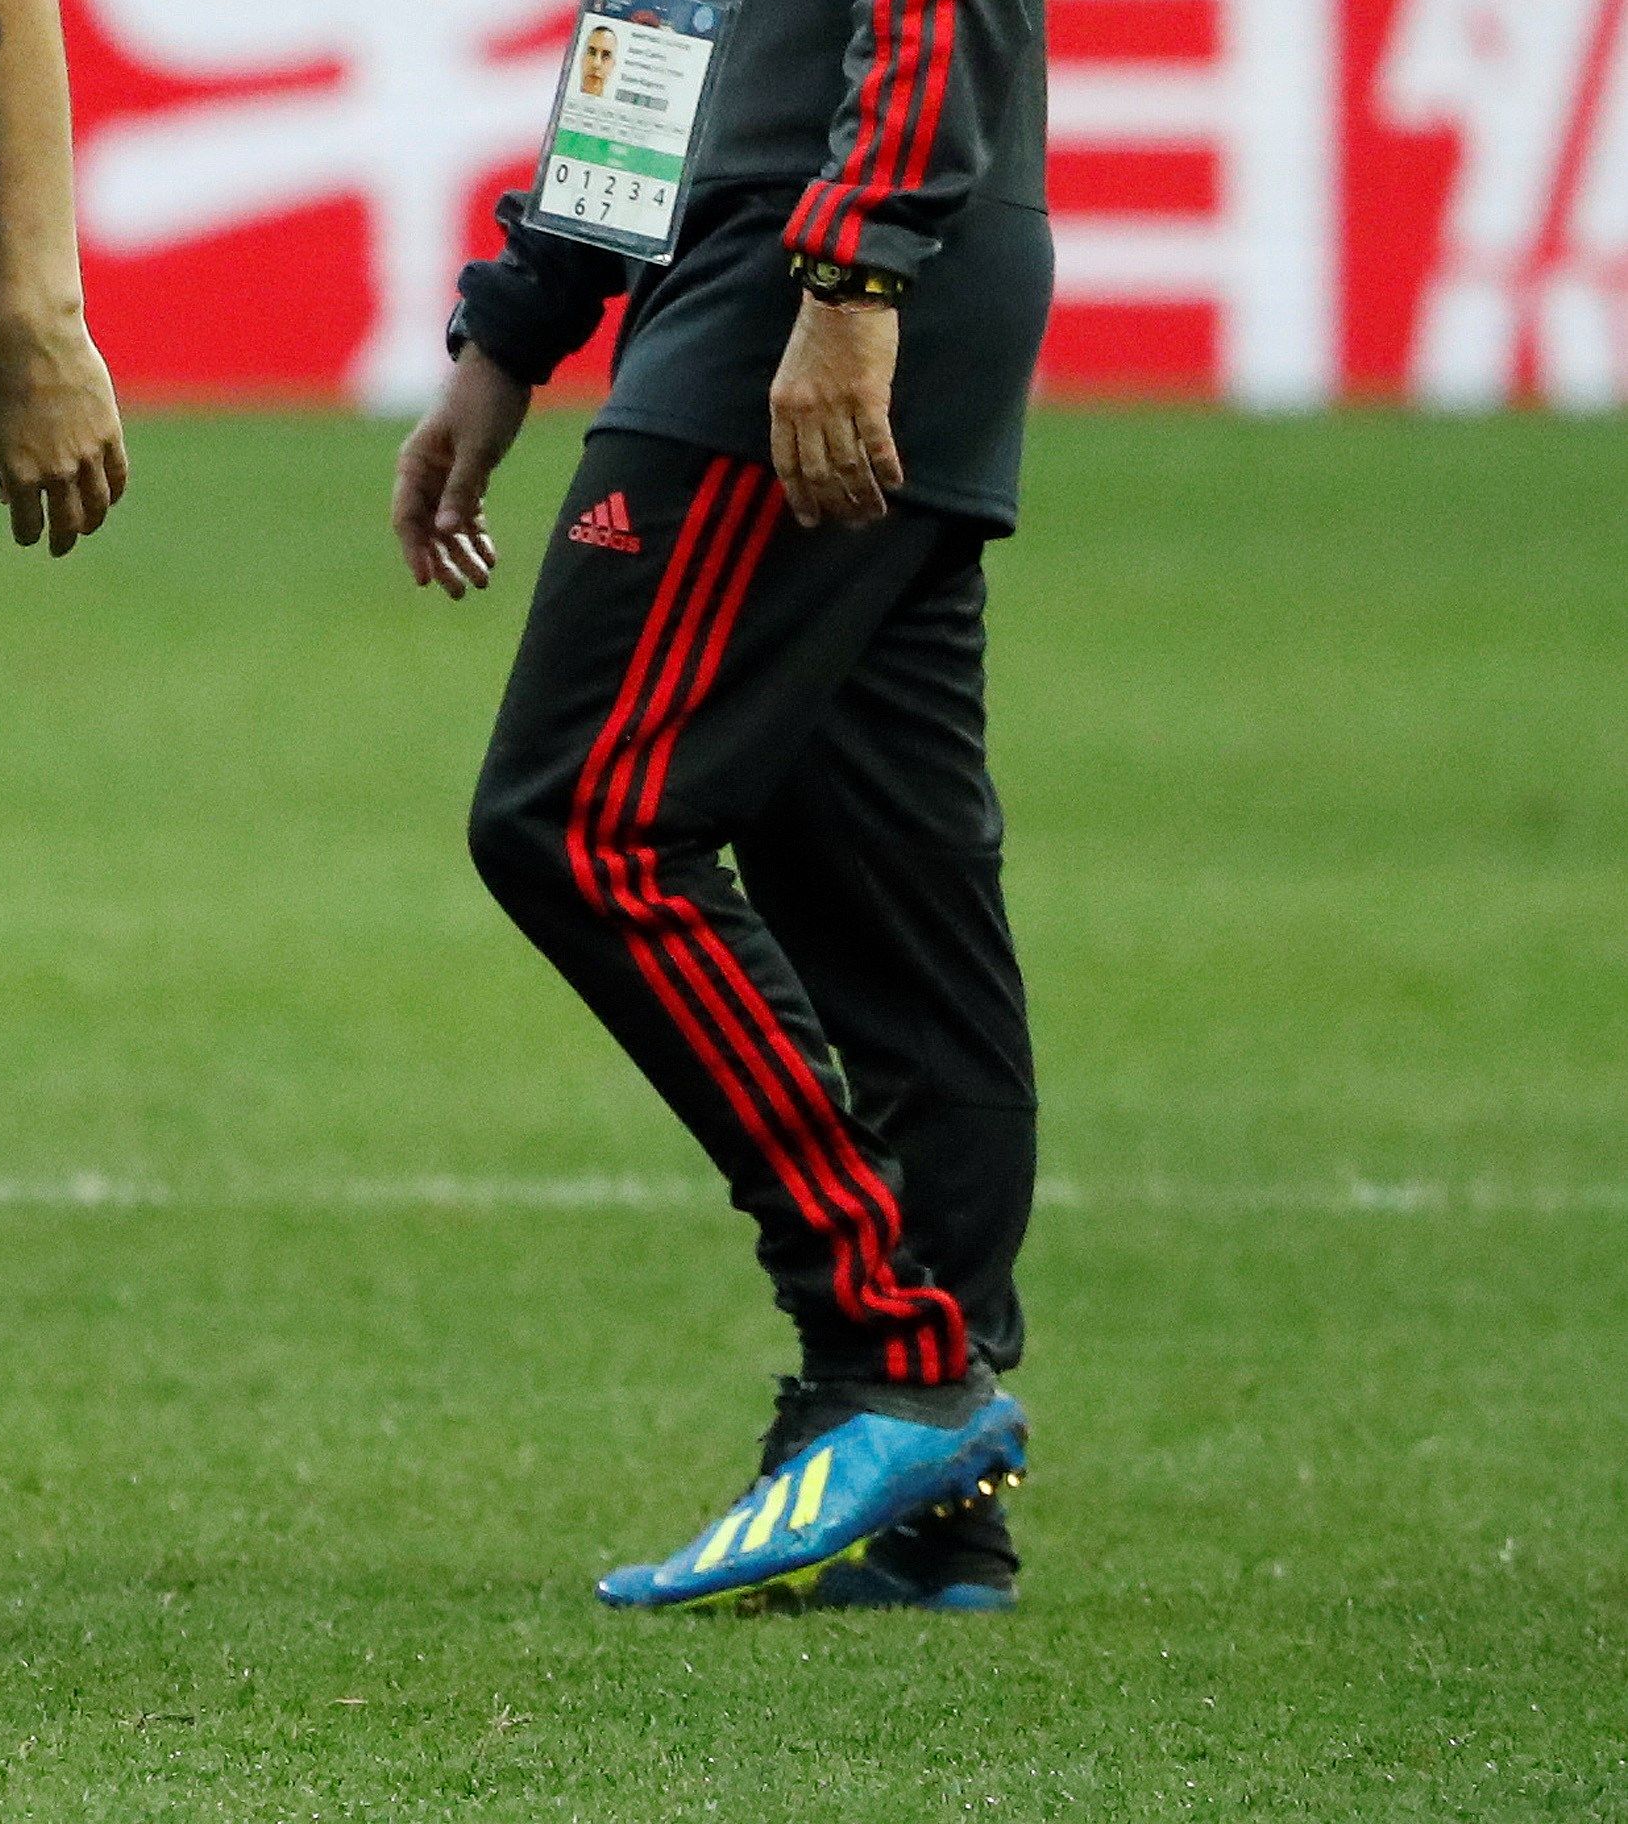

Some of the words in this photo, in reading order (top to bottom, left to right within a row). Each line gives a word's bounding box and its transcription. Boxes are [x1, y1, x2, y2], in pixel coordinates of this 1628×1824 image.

[556, 164, 569, 183] 0
[583, 169, 591, 189] 1
[604, 175, 616, 195] 2
[629, 181, 641, 201] 3
[653, 187, 666, 206] 4
[574, 197, 585, 216] 6
[600, 201, 611, 221] 7
[568, 521, 641, 554] adidas
